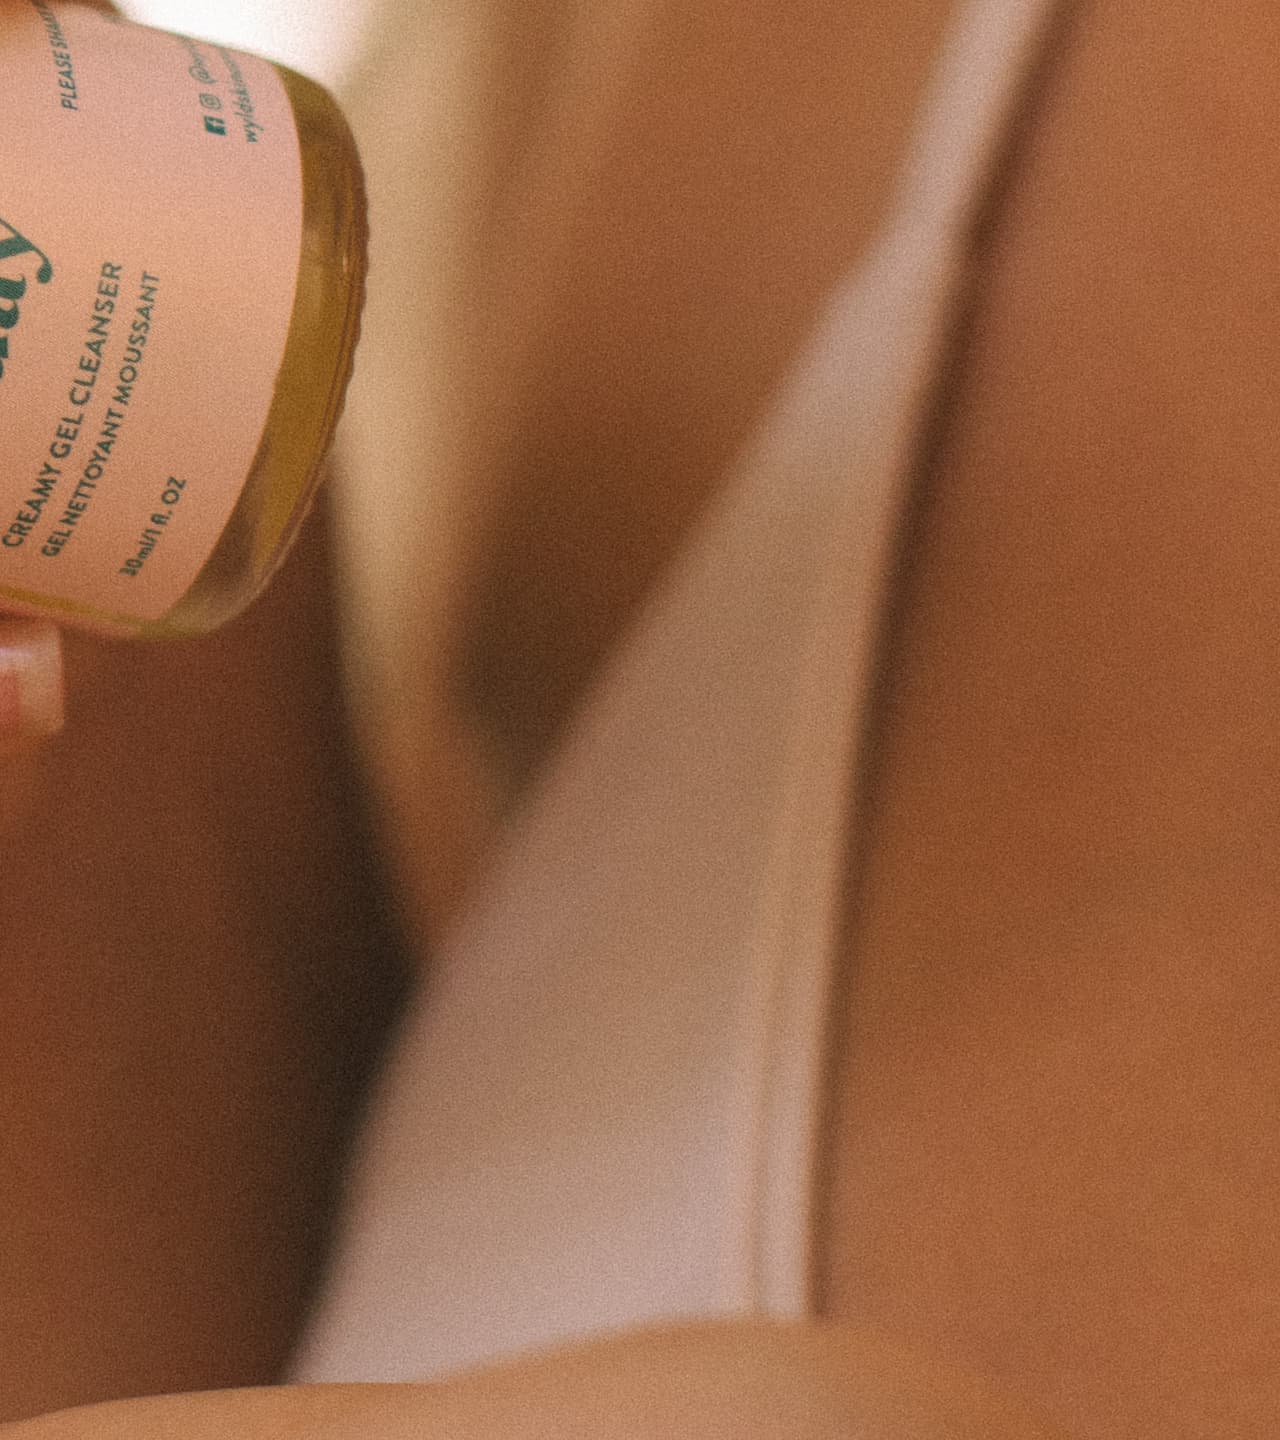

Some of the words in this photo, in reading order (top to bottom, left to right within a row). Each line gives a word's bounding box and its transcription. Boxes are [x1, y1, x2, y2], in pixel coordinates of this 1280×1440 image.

[54, 48, 79, 111] PLEASE
[1, 462, 62, 549] CREAMY
[50, 412, 85, 460] GEL
[69, 261, 124, 407] CLEANSER
[41, 527, 73, 559] GEL
[63, 408, 125, 527] NETTOYANT
[113, 271, 161, 406] MOUSSANT
[161, 475, 188, 507] OZ
